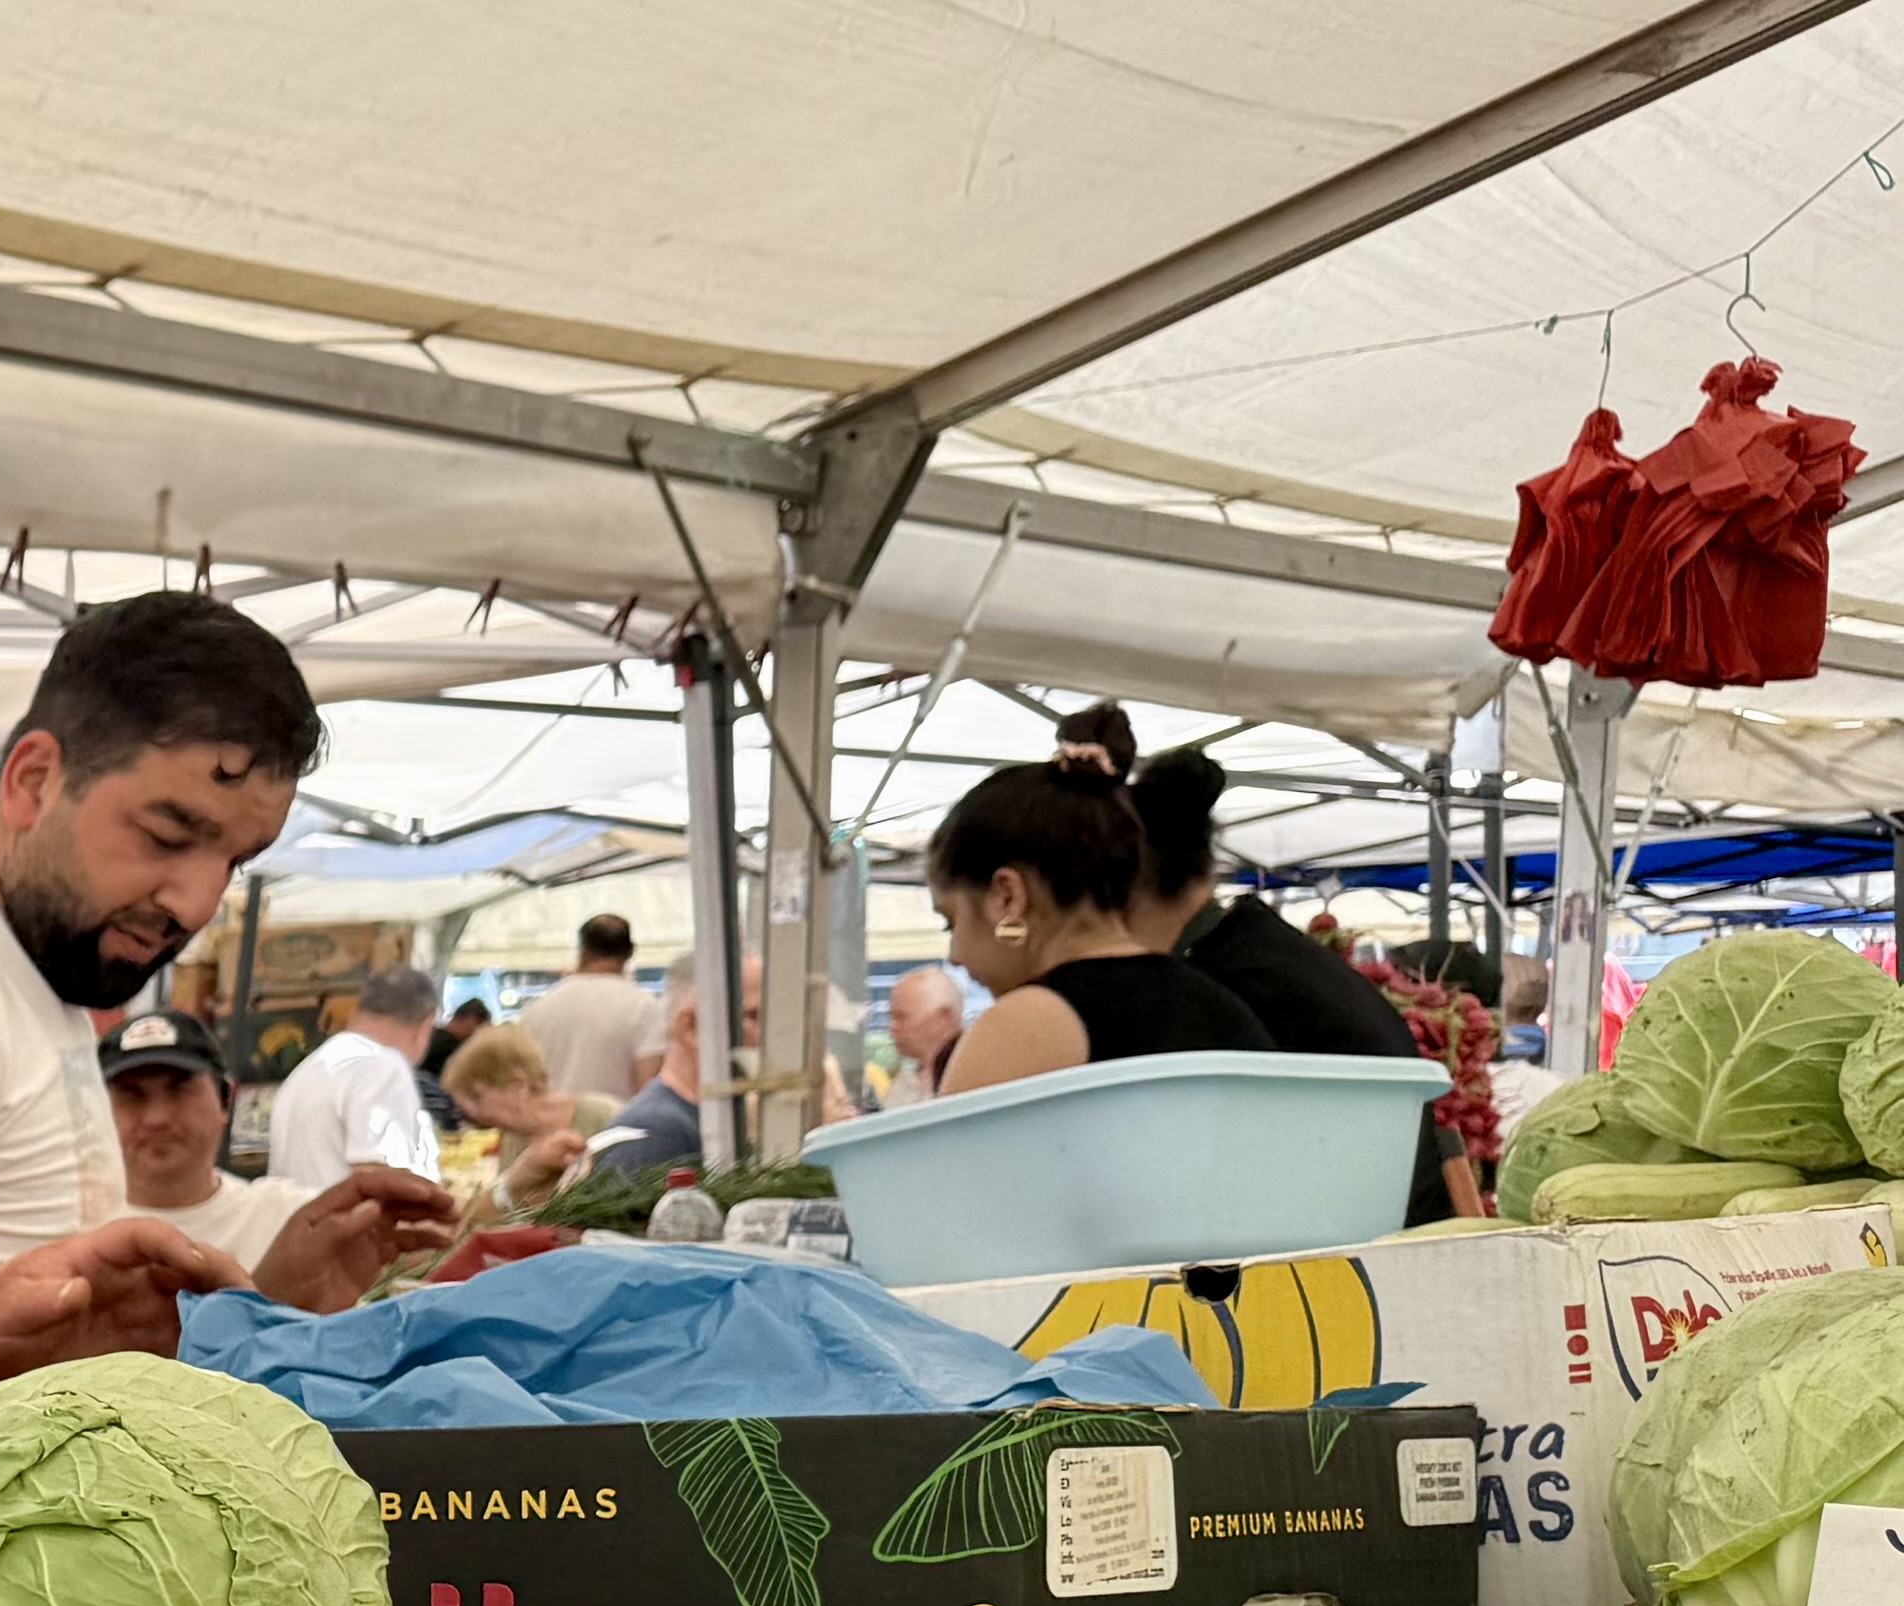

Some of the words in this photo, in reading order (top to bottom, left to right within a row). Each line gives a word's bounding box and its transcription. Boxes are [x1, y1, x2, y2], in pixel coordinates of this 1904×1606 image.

[378, 1487, 619, 1521] BANANAS
[1189, 1511, 1277, 1539] PREMIUM
[1284, 1507, 1365, 1534] BANANAS
